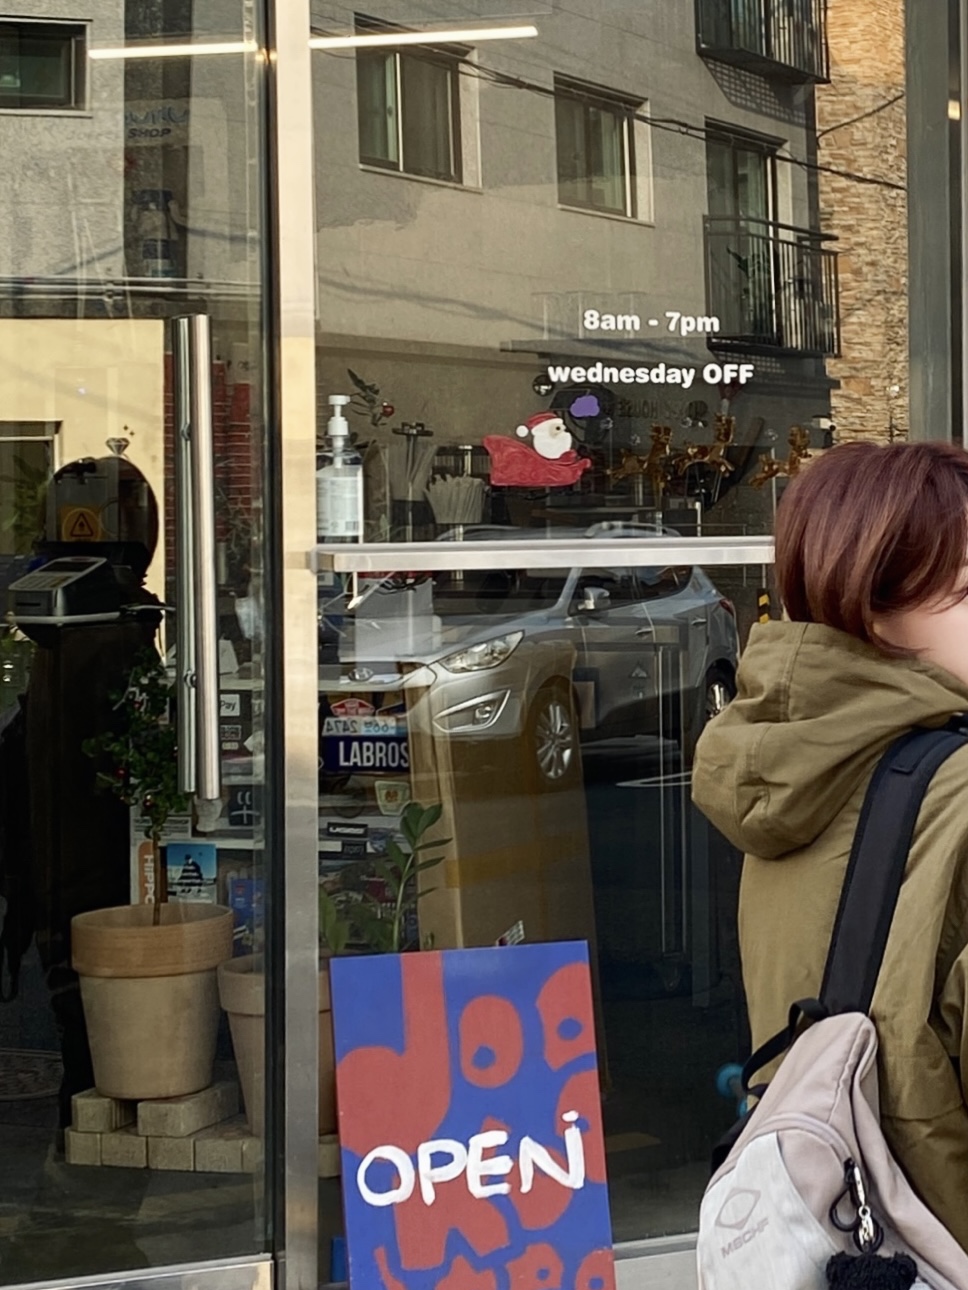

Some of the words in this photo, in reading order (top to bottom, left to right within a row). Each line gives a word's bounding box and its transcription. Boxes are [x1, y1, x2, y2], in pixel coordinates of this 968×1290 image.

[127, 128, 172, 139] SHOP
[583, 309, 641, 331] 8am
[665, 311, 721, 336] 7pm
[547, 361, 697, 389] wednesday
[702, 363, 755, 385] OFF
